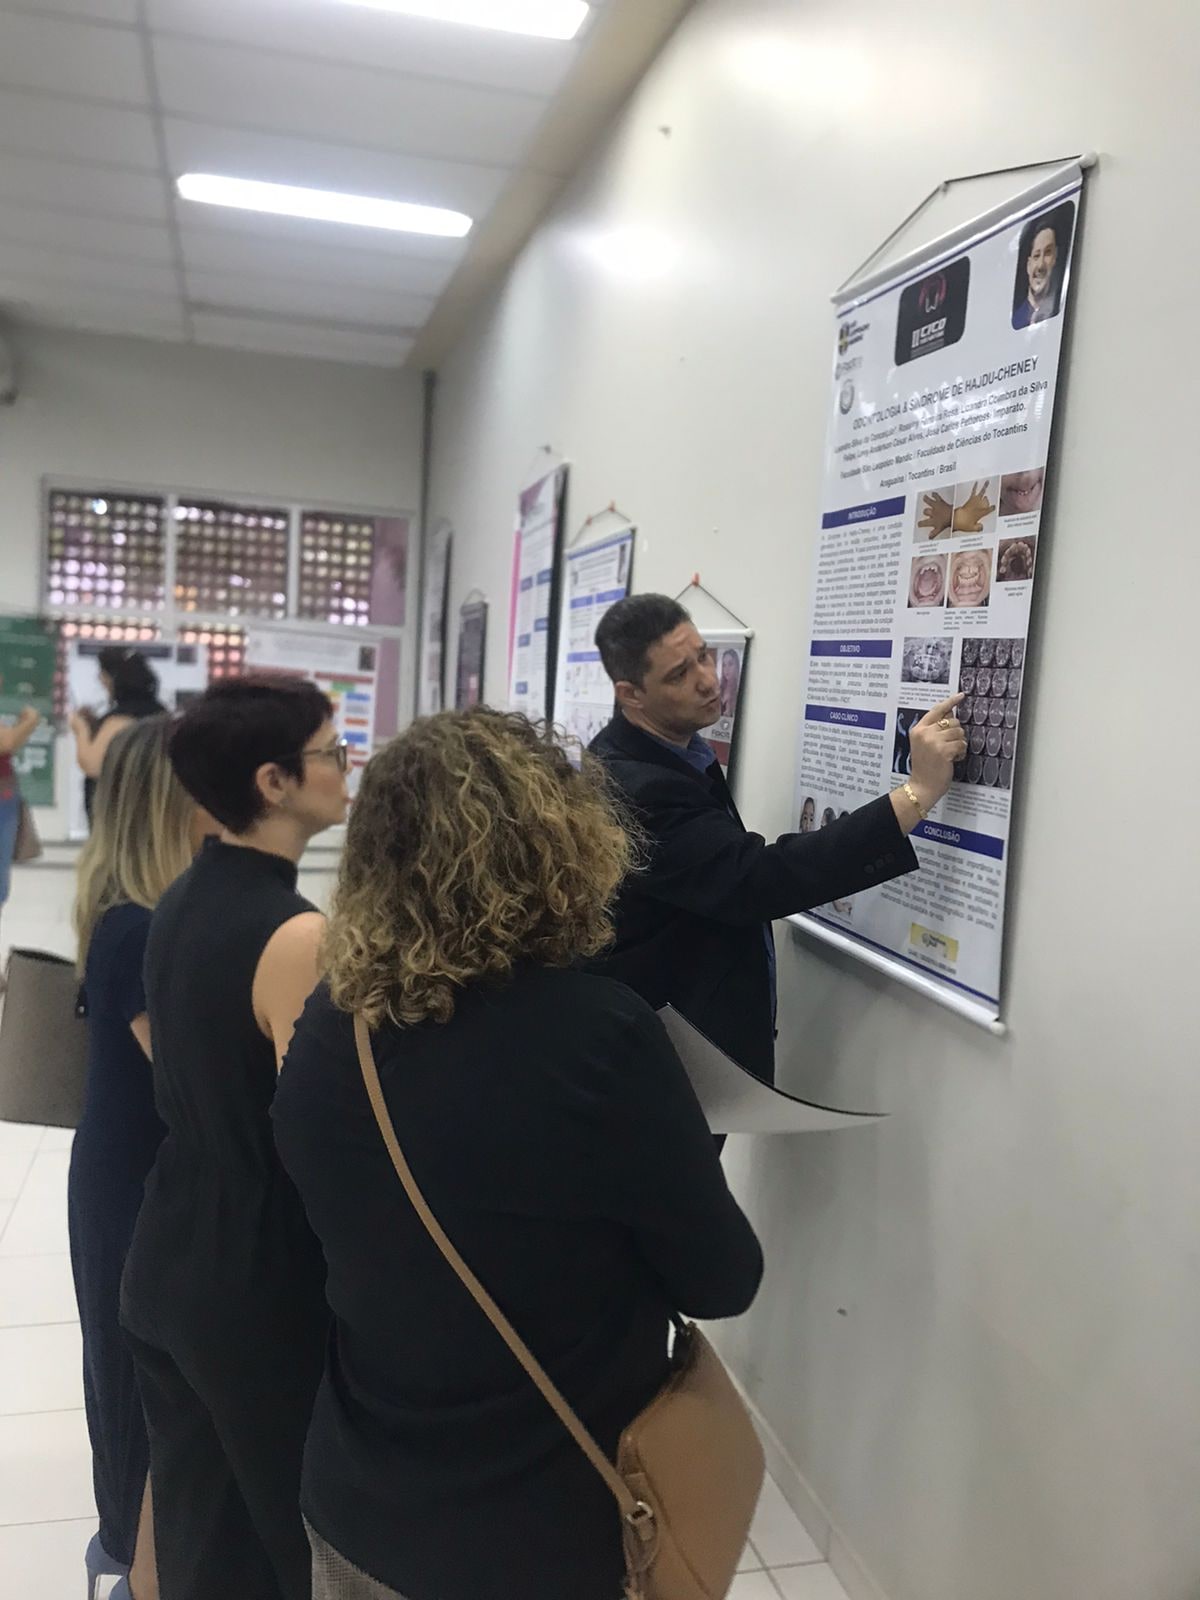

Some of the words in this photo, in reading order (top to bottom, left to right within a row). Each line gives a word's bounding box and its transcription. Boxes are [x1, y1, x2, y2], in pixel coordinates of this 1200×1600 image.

[951, 382, 964, 398] DE
[964, 356, 1039, 392] HAJDU-CHENEY
[1018, 385, 1028, 396] da
[1029, 380, 1048, 393] Silva
[955, 434, 982, 449] Ciências
[982, 431, 992, 443] do
[993, 422, 1028, 438] Tocantins
[908, 466, 935, 480] Tocantins
[939, 461, 957, 474] Brasil
[923, 825, 960, 843] CONCLUSÃO
